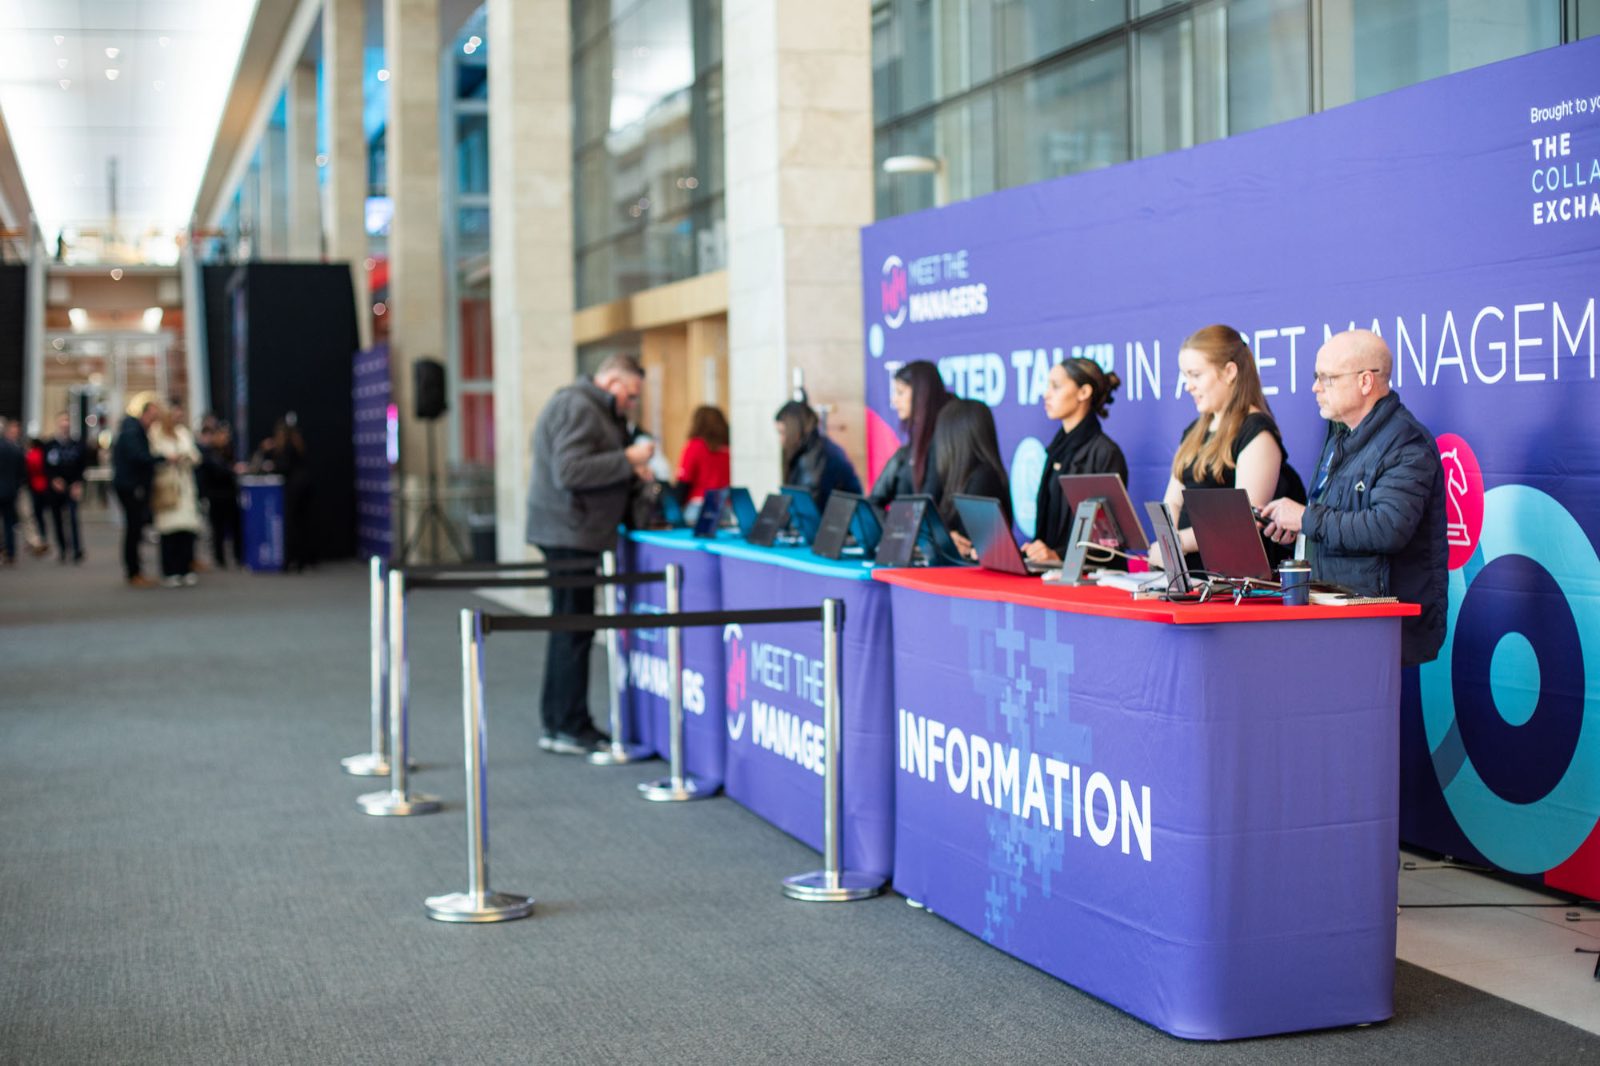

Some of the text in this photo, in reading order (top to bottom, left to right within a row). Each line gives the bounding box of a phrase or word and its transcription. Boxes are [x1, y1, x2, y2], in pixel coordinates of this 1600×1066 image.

[1530, 100, 1573, 123] Brought
[1576, 98, 1588, 114] to
[1532, 132, 1571, 161] THE
[1532, 158, 1600, 194] COLLA
[1533, 193, 1600, 225] EXCHA
[908, 250, 969, 287] MEET THE
[909, 283, 989, 323] MANAGERS
[1126, 340, 1161, 401] IN
[751, 641, 825, 707] MEET THE
[899, 708, 1152, 863] INFORMATION
